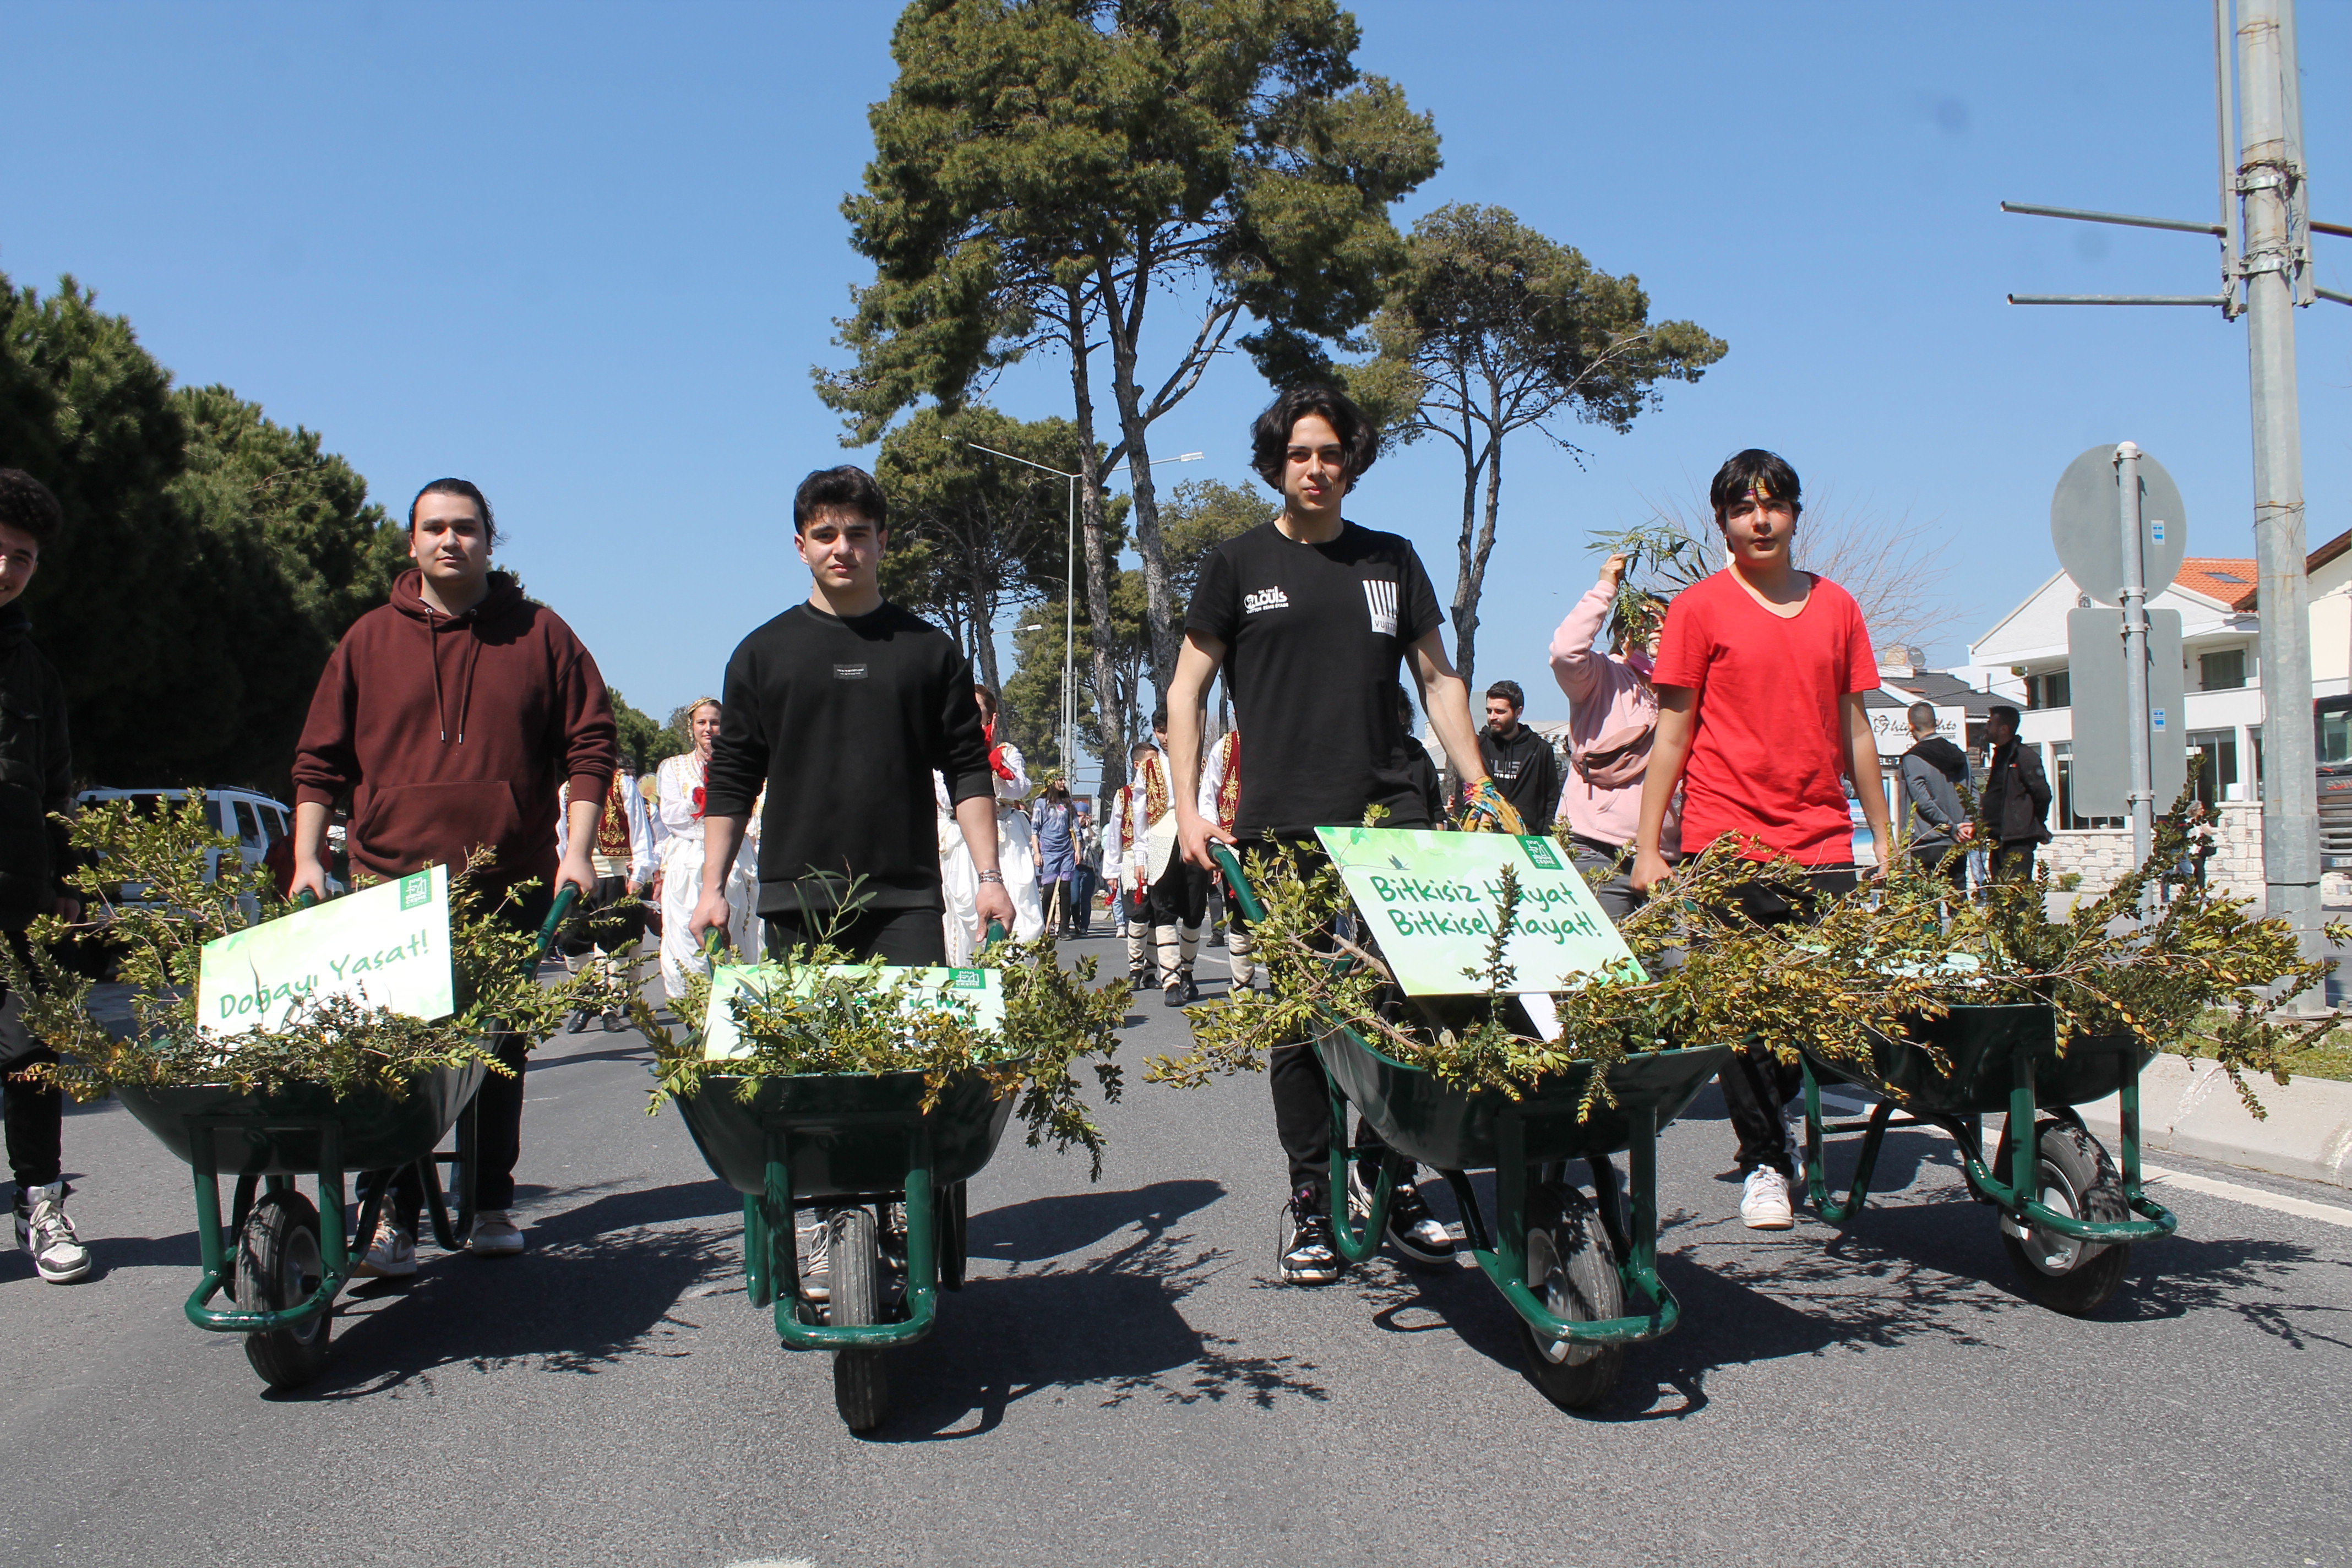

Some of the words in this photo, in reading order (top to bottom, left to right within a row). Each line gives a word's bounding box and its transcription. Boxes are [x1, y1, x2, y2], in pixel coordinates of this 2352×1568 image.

[1370, 876, 1481, 903] Bitkisiz
[1387, 908, 1495, 936] Bitkisel
[220, 974, 318, 1019] Doğayı
[329, 929, 429, 981] Yaşat!
